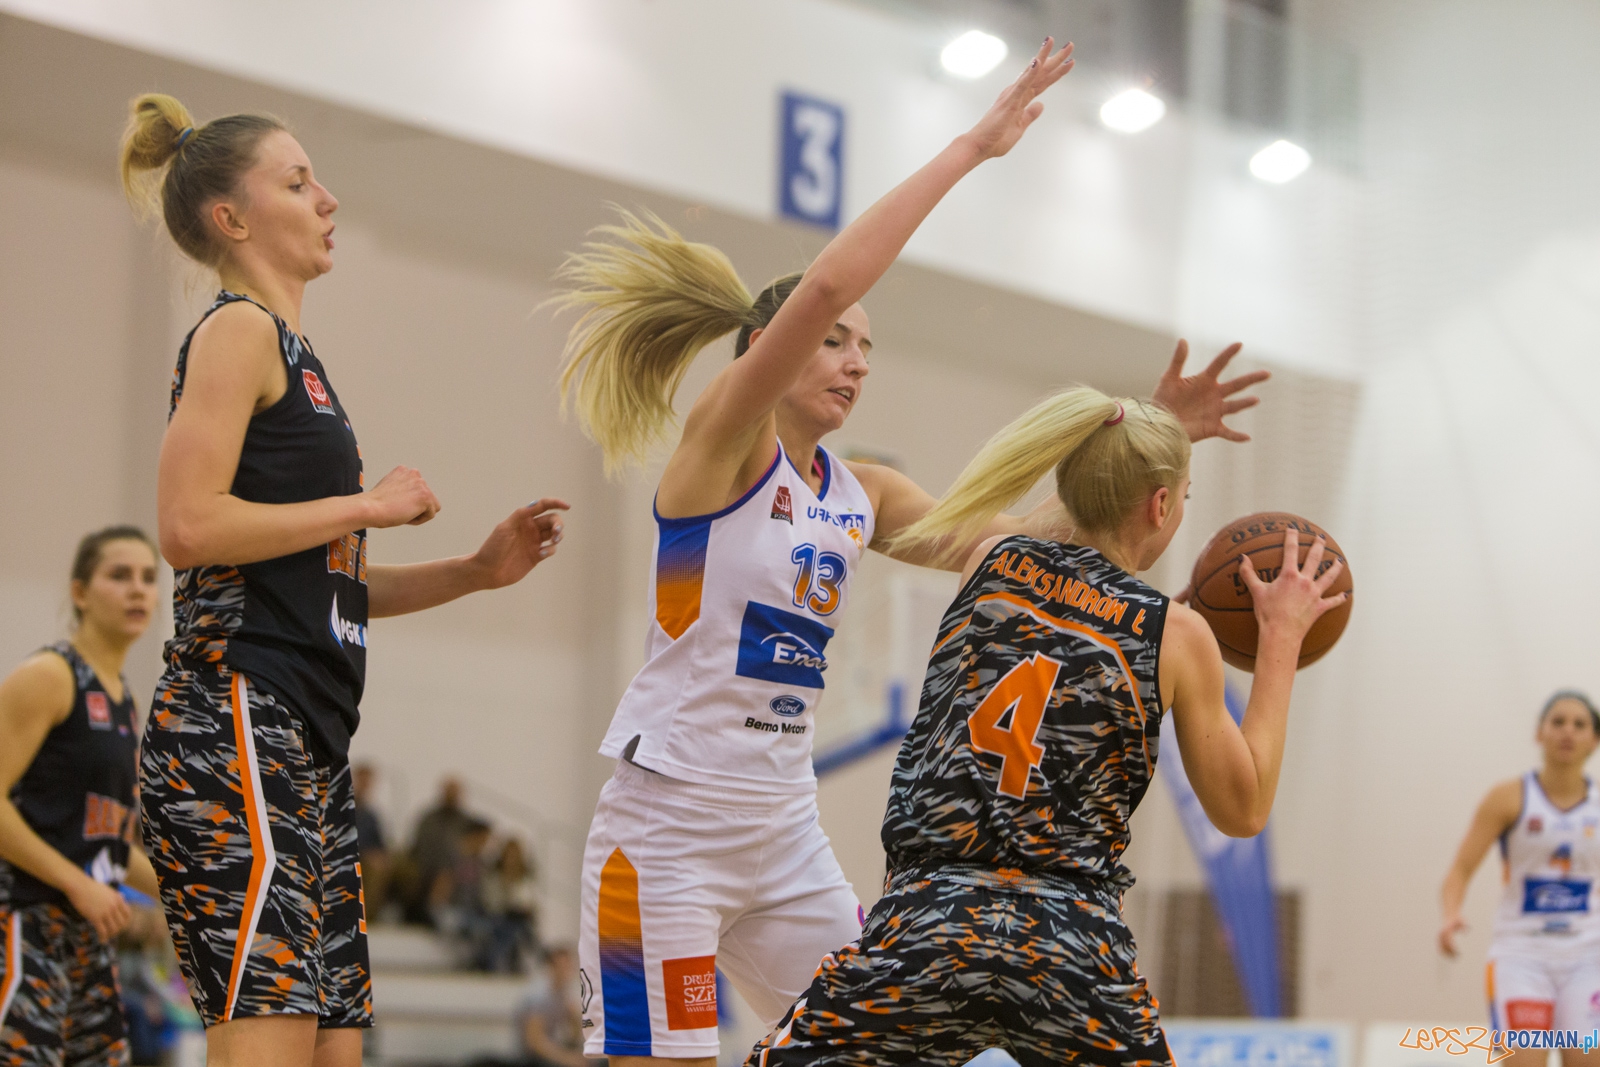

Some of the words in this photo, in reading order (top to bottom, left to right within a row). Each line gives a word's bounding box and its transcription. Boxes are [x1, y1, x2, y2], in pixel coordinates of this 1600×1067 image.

[791, 104, 836, 216] 3
[791, 542, 847, 617] 13
[987, 550, 1129, 626] ALEKSANDRÓW
[744, 717, 779, 732] Bemo
[776, 697, 801, 714] Ford
[967, 650, 1063, 802] 4
